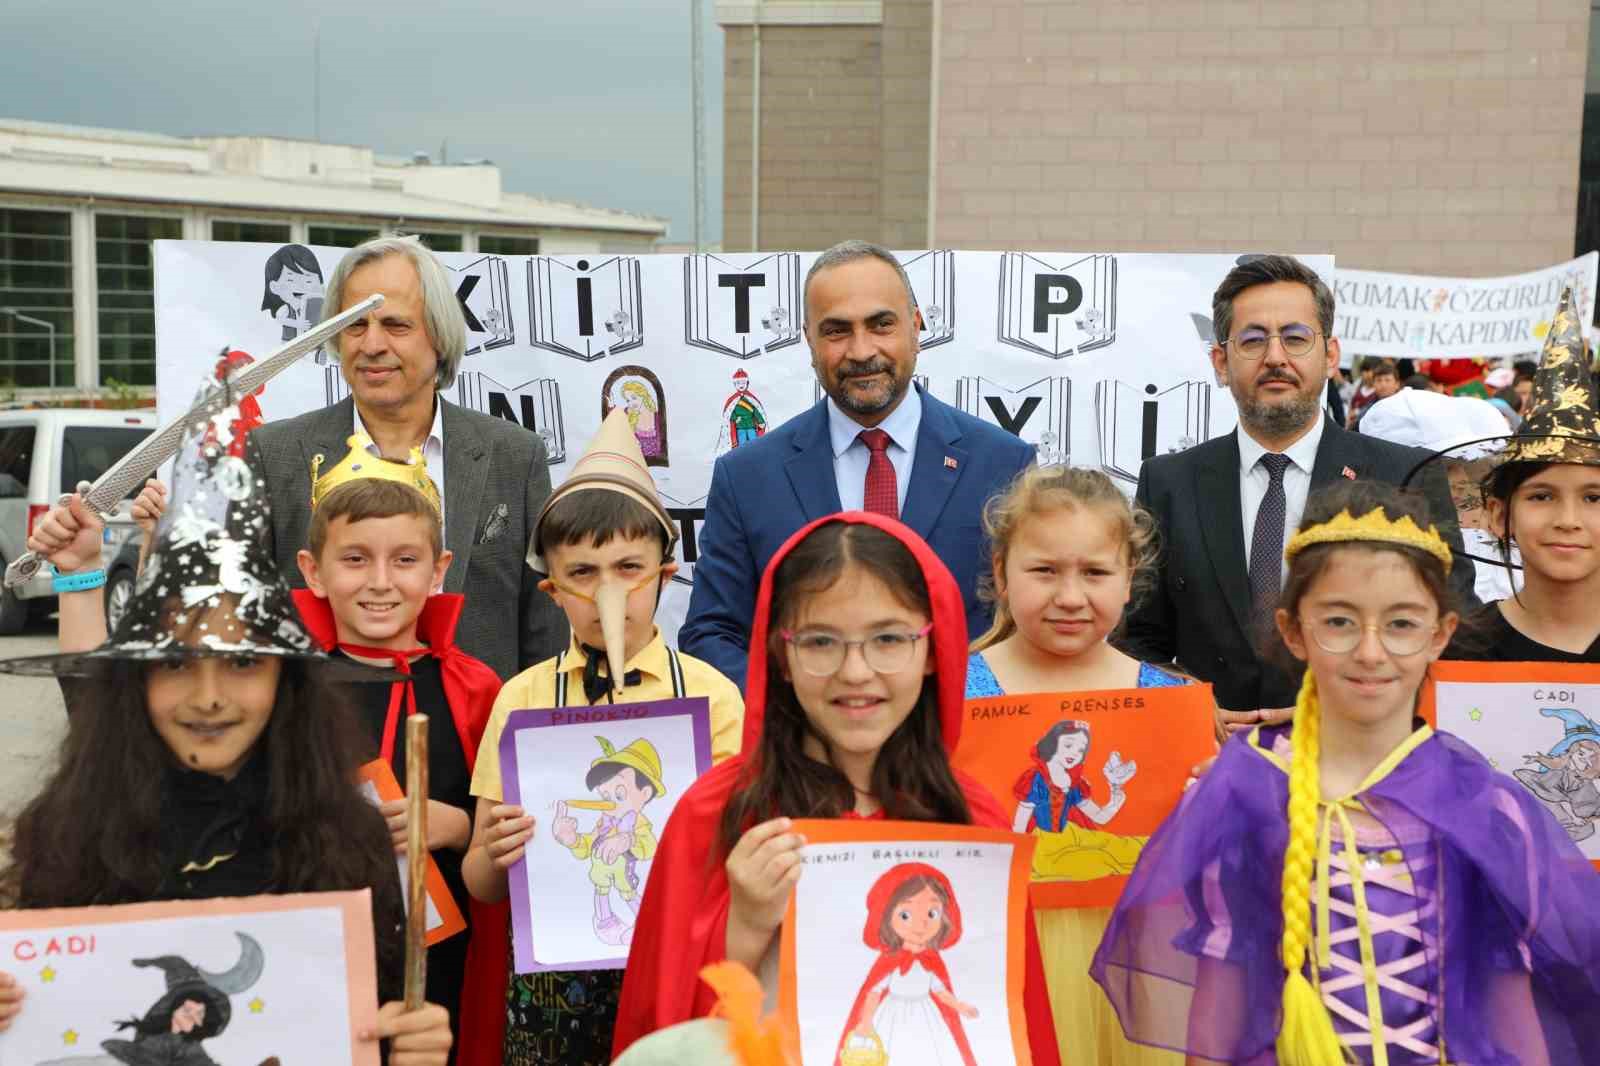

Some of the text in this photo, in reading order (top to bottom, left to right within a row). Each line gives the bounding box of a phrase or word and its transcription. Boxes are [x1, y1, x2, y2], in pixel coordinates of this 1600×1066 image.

[1333, 279, 1432, 312] KUMAK
[1429, 317, 1529, 345] KAPIDIR
[971, 697, 1145, 720] PAMUK PRENSES
[1533, 689, 1575, 703] CADI
[13, 935, 96, 961] CADI
